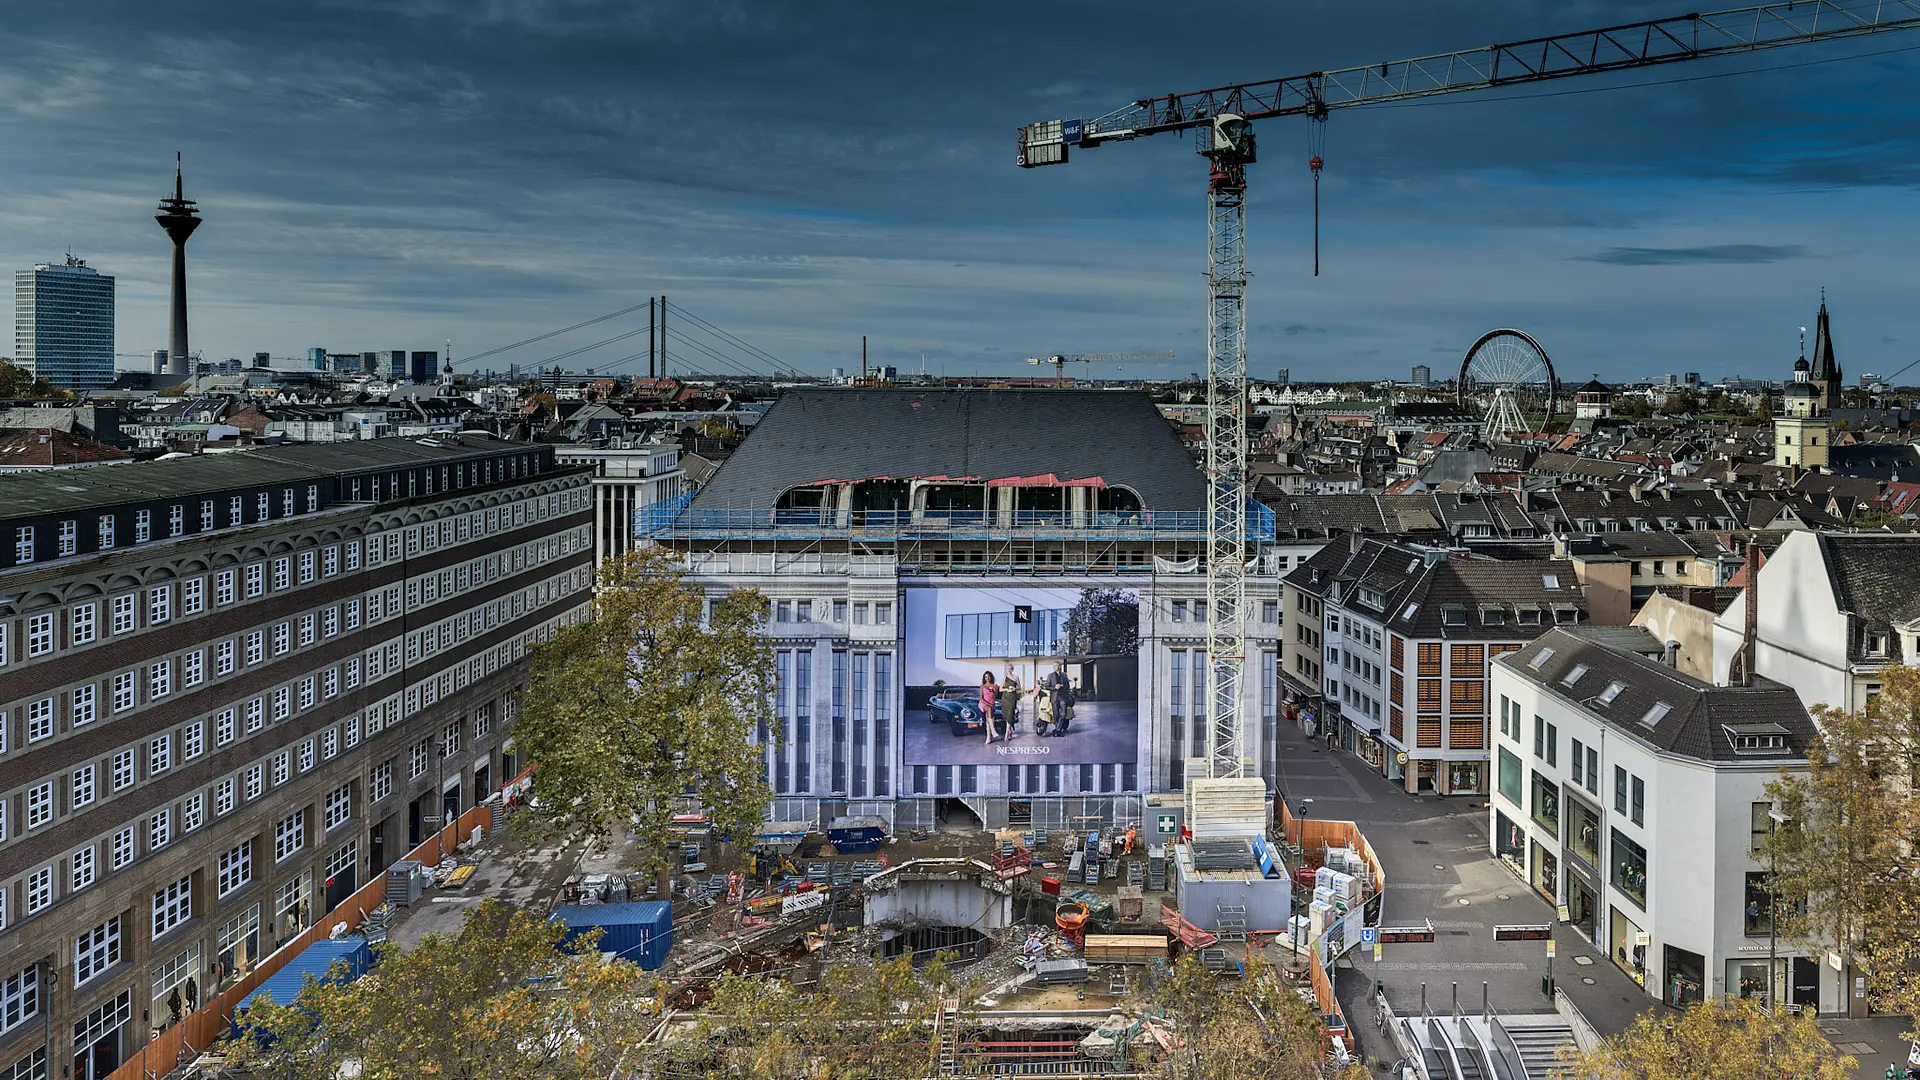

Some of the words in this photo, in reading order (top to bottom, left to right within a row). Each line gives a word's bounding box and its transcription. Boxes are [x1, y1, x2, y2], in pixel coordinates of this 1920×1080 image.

[1016, 608, 1029, 620] N
[995, 745, 1050, 756] NESPRESSO
[1363, 930, 1373, 940] U
